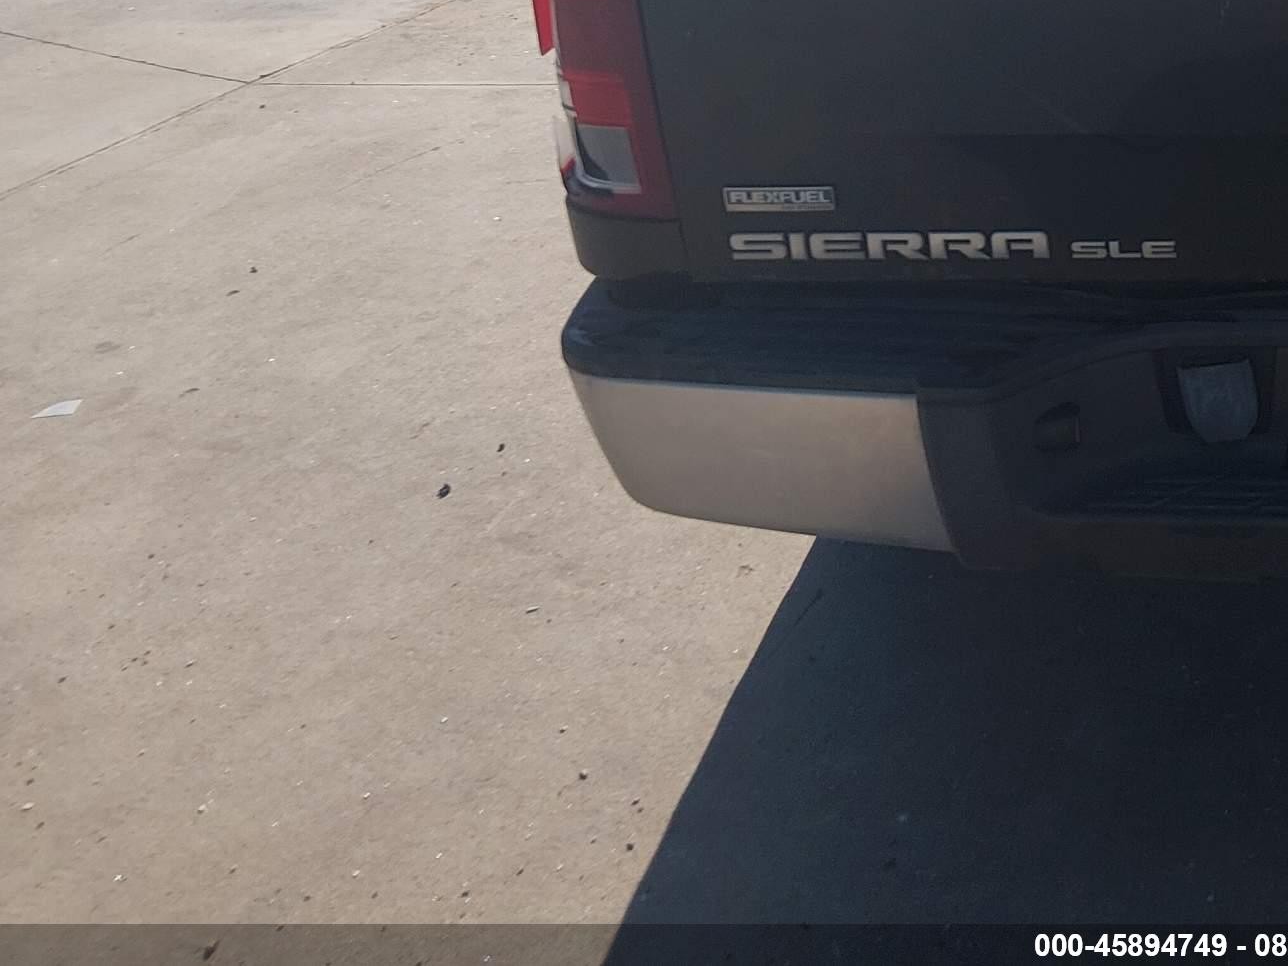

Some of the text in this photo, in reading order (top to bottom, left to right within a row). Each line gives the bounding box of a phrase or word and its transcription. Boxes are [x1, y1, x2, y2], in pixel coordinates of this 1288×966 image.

[730, 190, 832, 203] FLEXFUEL
[729, 231, 1177, 261] SIERRA SLE
